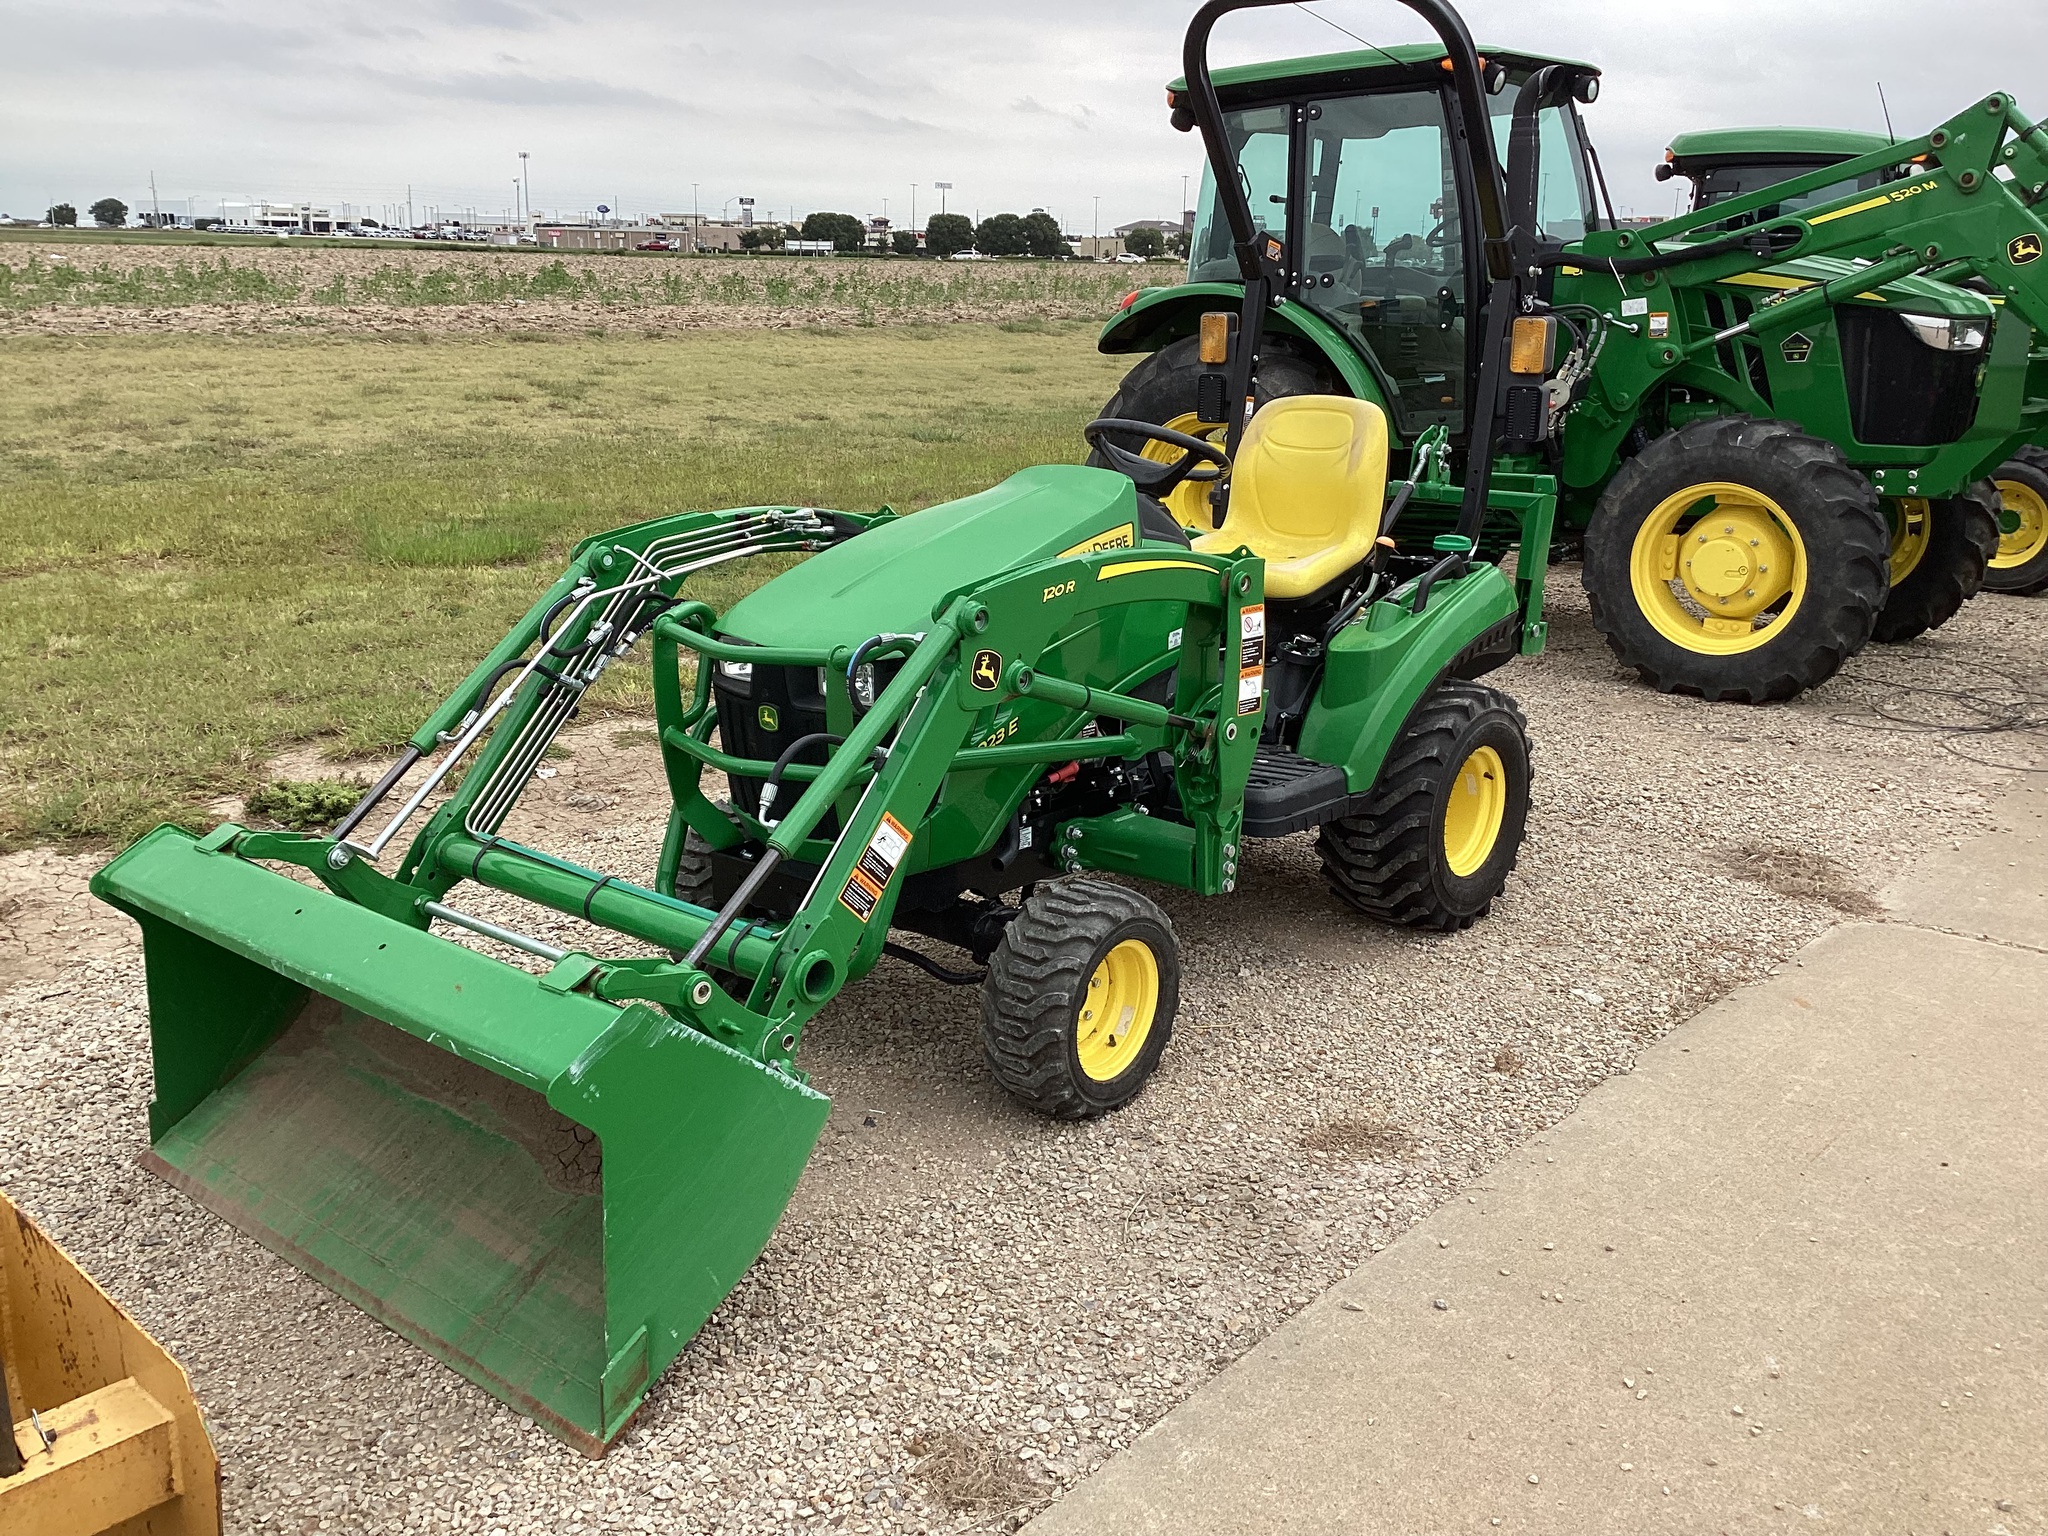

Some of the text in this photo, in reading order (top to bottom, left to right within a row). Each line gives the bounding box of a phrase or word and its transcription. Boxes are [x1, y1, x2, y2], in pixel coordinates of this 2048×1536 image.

[1889, 180, 1938, 202] 520 M
[1092, 534, 1130, 552] DEERE
[1043, 580, 1076, 603] 120 R
[1008, 716, 1019, 737] E
[890, 819, 910, 840] WARNING
[859, 877, 879, 897] WARNING
